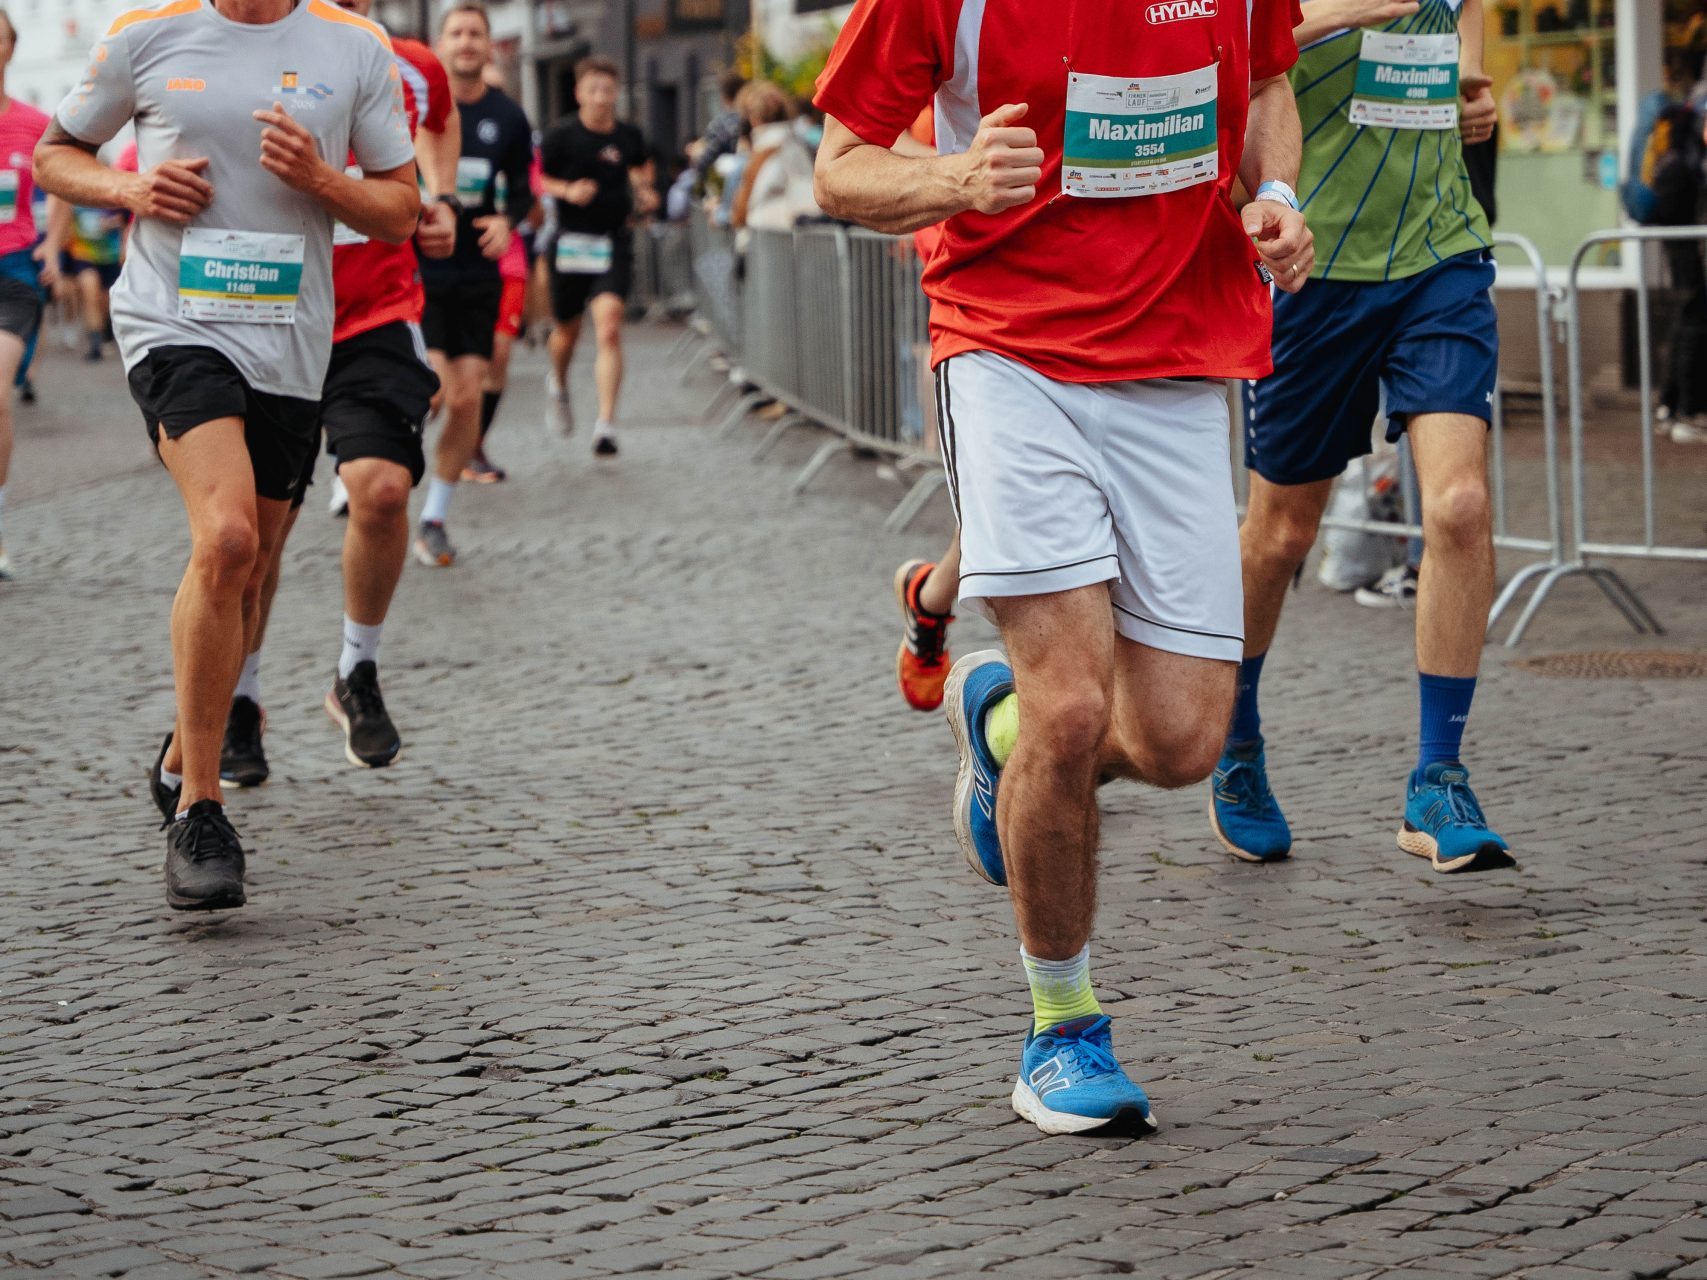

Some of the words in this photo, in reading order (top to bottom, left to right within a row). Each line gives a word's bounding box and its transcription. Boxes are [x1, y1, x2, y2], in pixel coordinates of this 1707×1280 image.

[1150, 0, 1215, 22] HYDAC
[1375, 64, 1450, 85] Maximilian
[1127, 99, 1147, 107] LAUF
[1089, 114, 1204, 141] Maximilian
[1135, 143, 1165, 157] 3554
[204, 260, 280, 282] Christian
